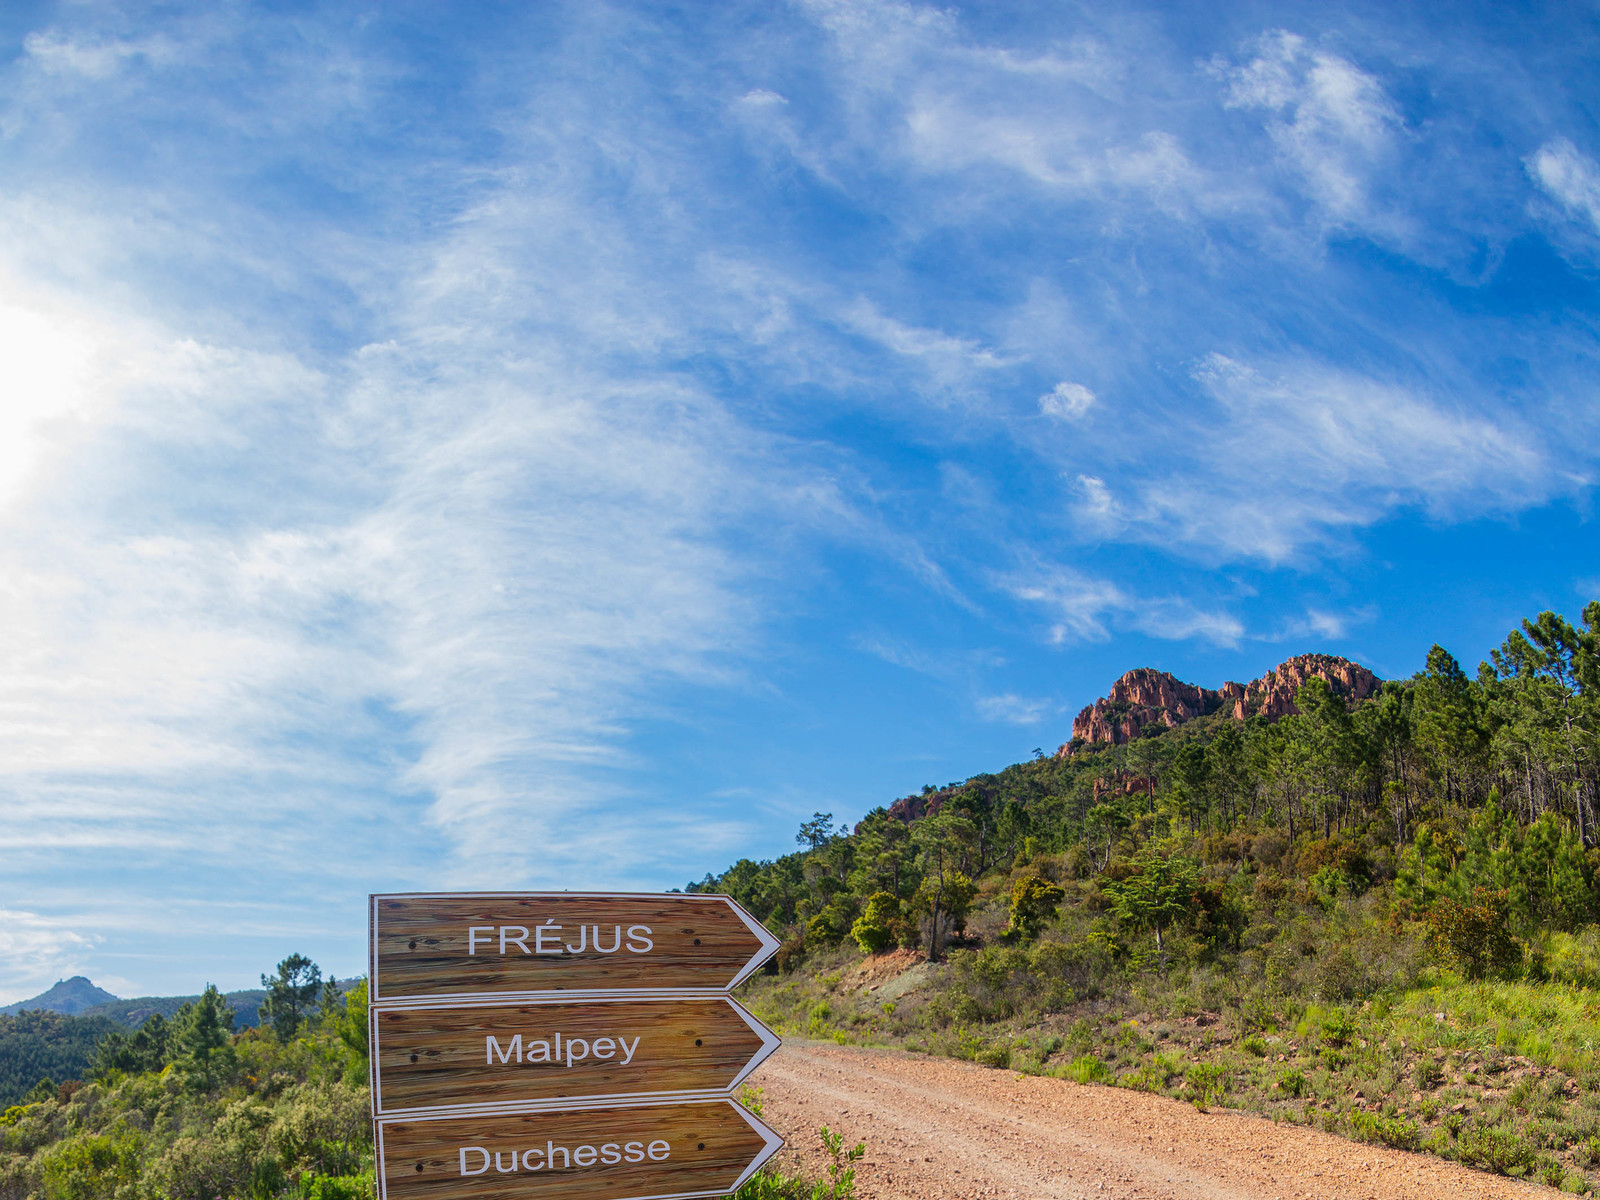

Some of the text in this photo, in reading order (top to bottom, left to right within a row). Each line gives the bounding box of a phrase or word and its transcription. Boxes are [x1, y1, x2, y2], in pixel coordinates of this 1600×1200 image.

[468, 918, 654, 956] FRÉJUS
[485, 1032, 641, 1067] Malpey
[458, 1139, 671, 1176] Duchesse
